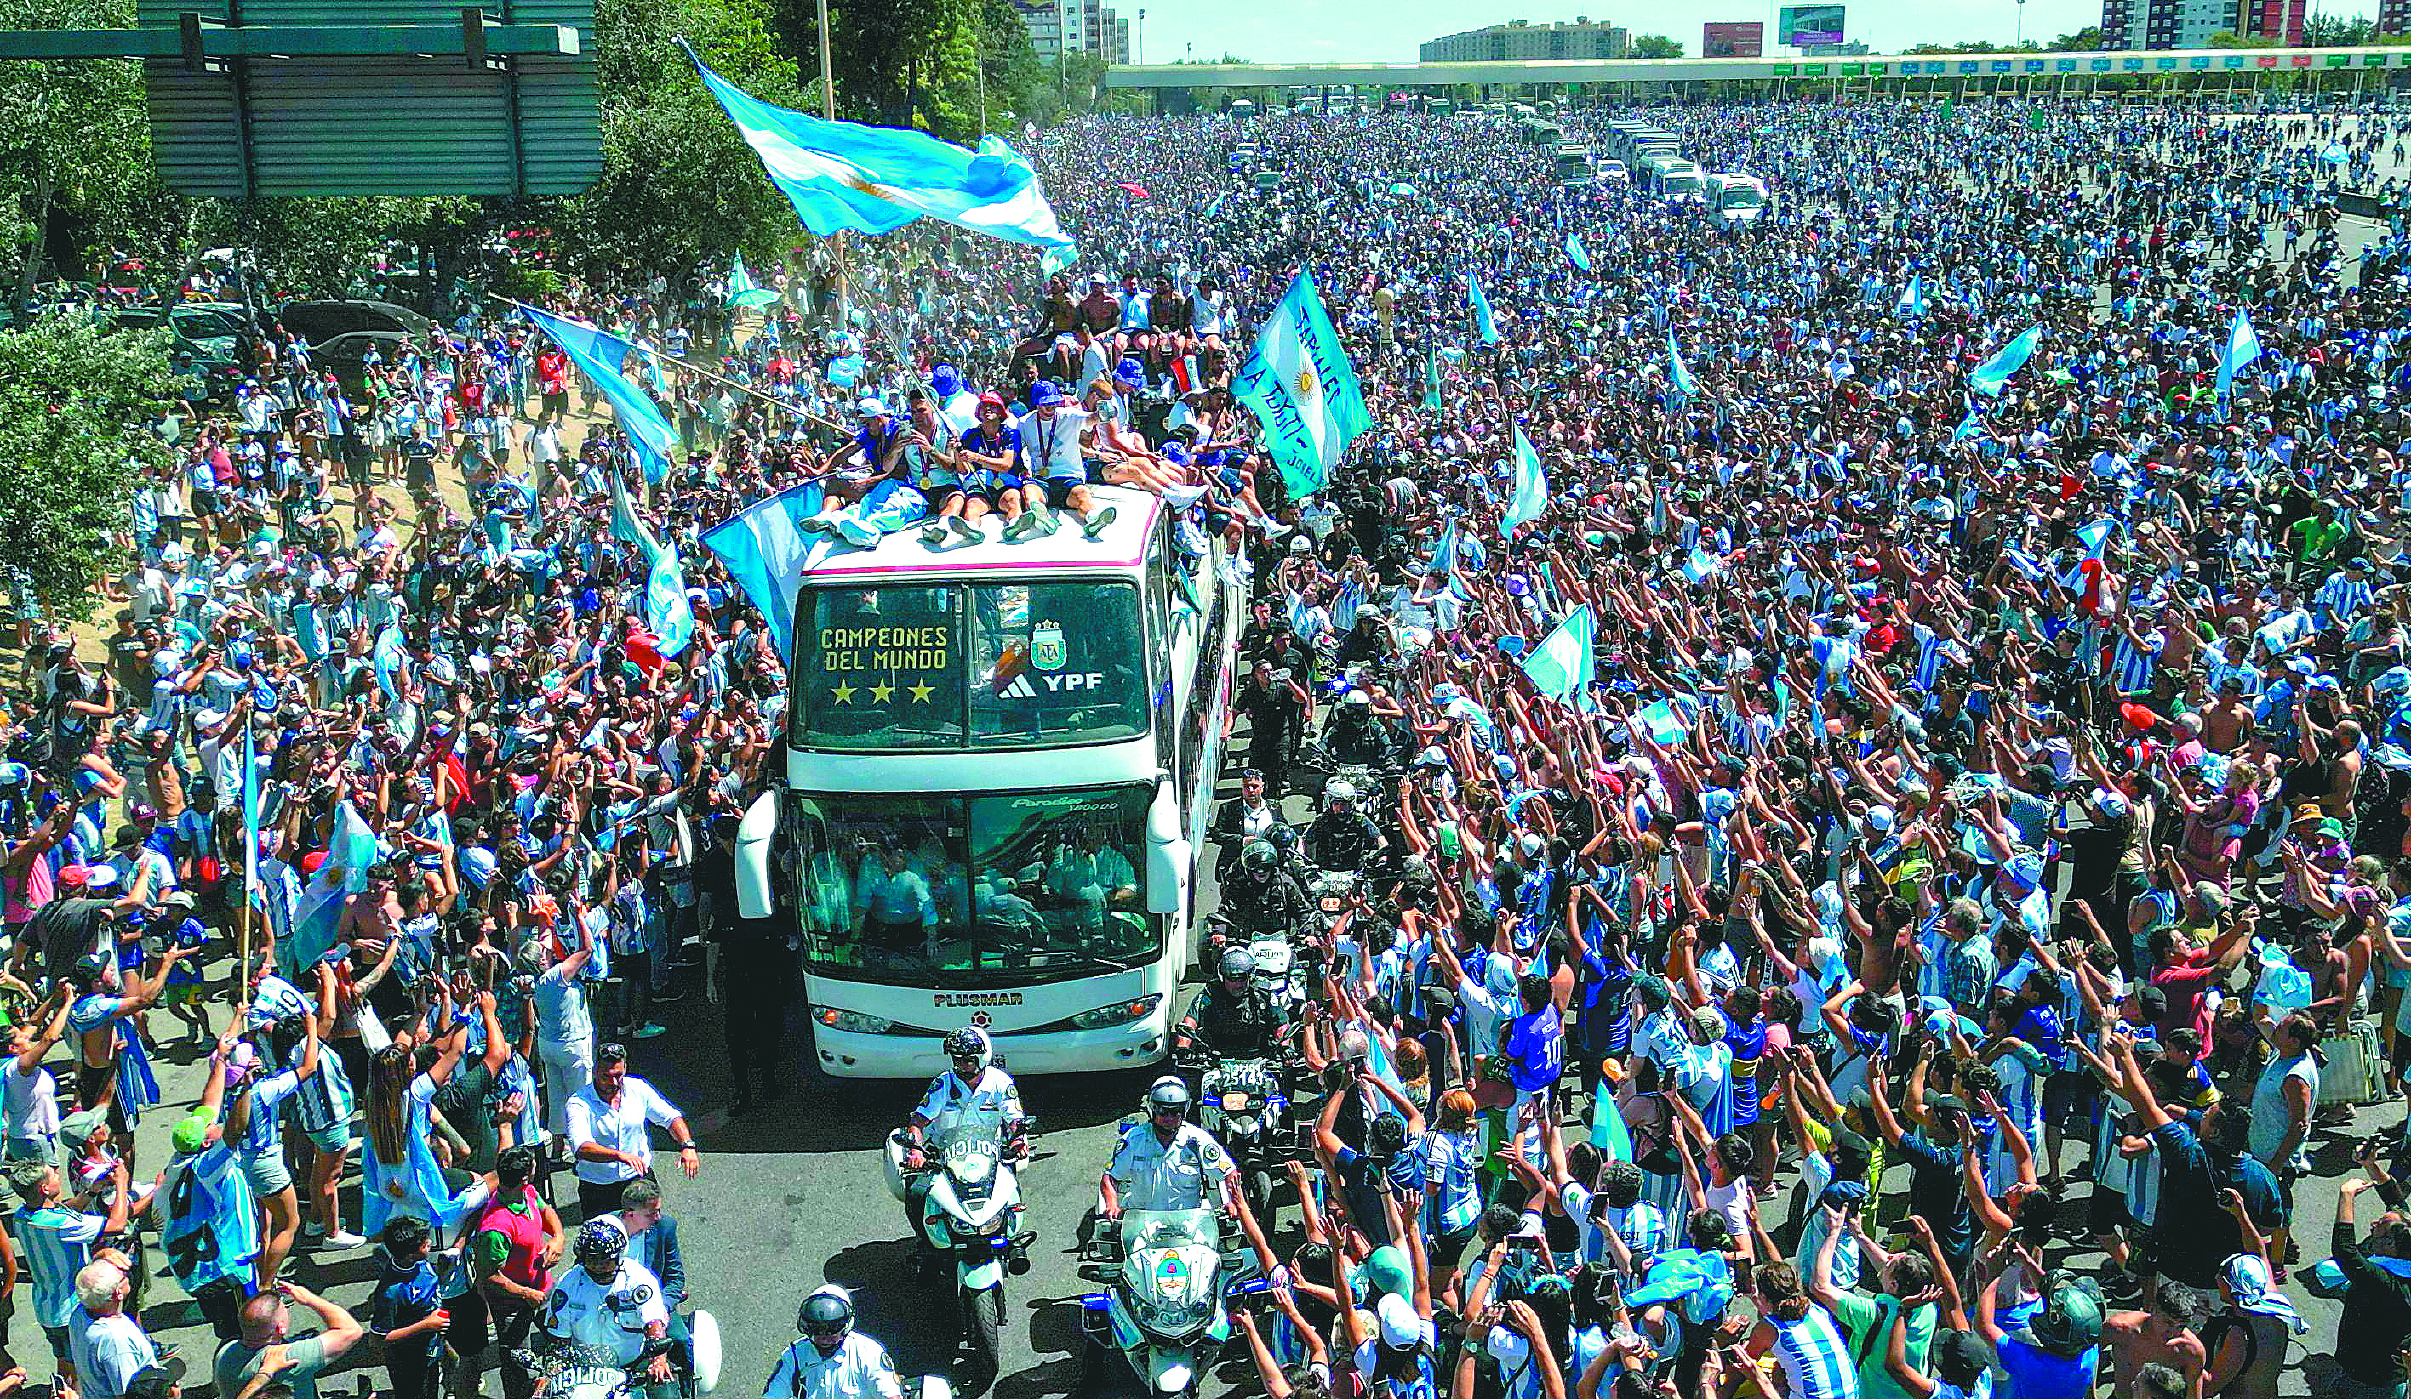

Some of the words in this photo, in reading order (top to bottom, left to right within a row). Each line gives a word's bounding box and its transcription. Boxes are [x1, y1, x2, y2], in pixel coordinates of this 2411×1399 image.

[1240, 352, 1267, 391] LA
[821, 626, 947, 649] CAMPEONES
[824, 651, 865, 671] DEL
[873, 649, 947, 670] MUNDO
[1042, 673, 1103, 692] YPF
[934, 993, 1022, 1007] PLUSMAR
[1543, 1036, 1561, 1071] 10
